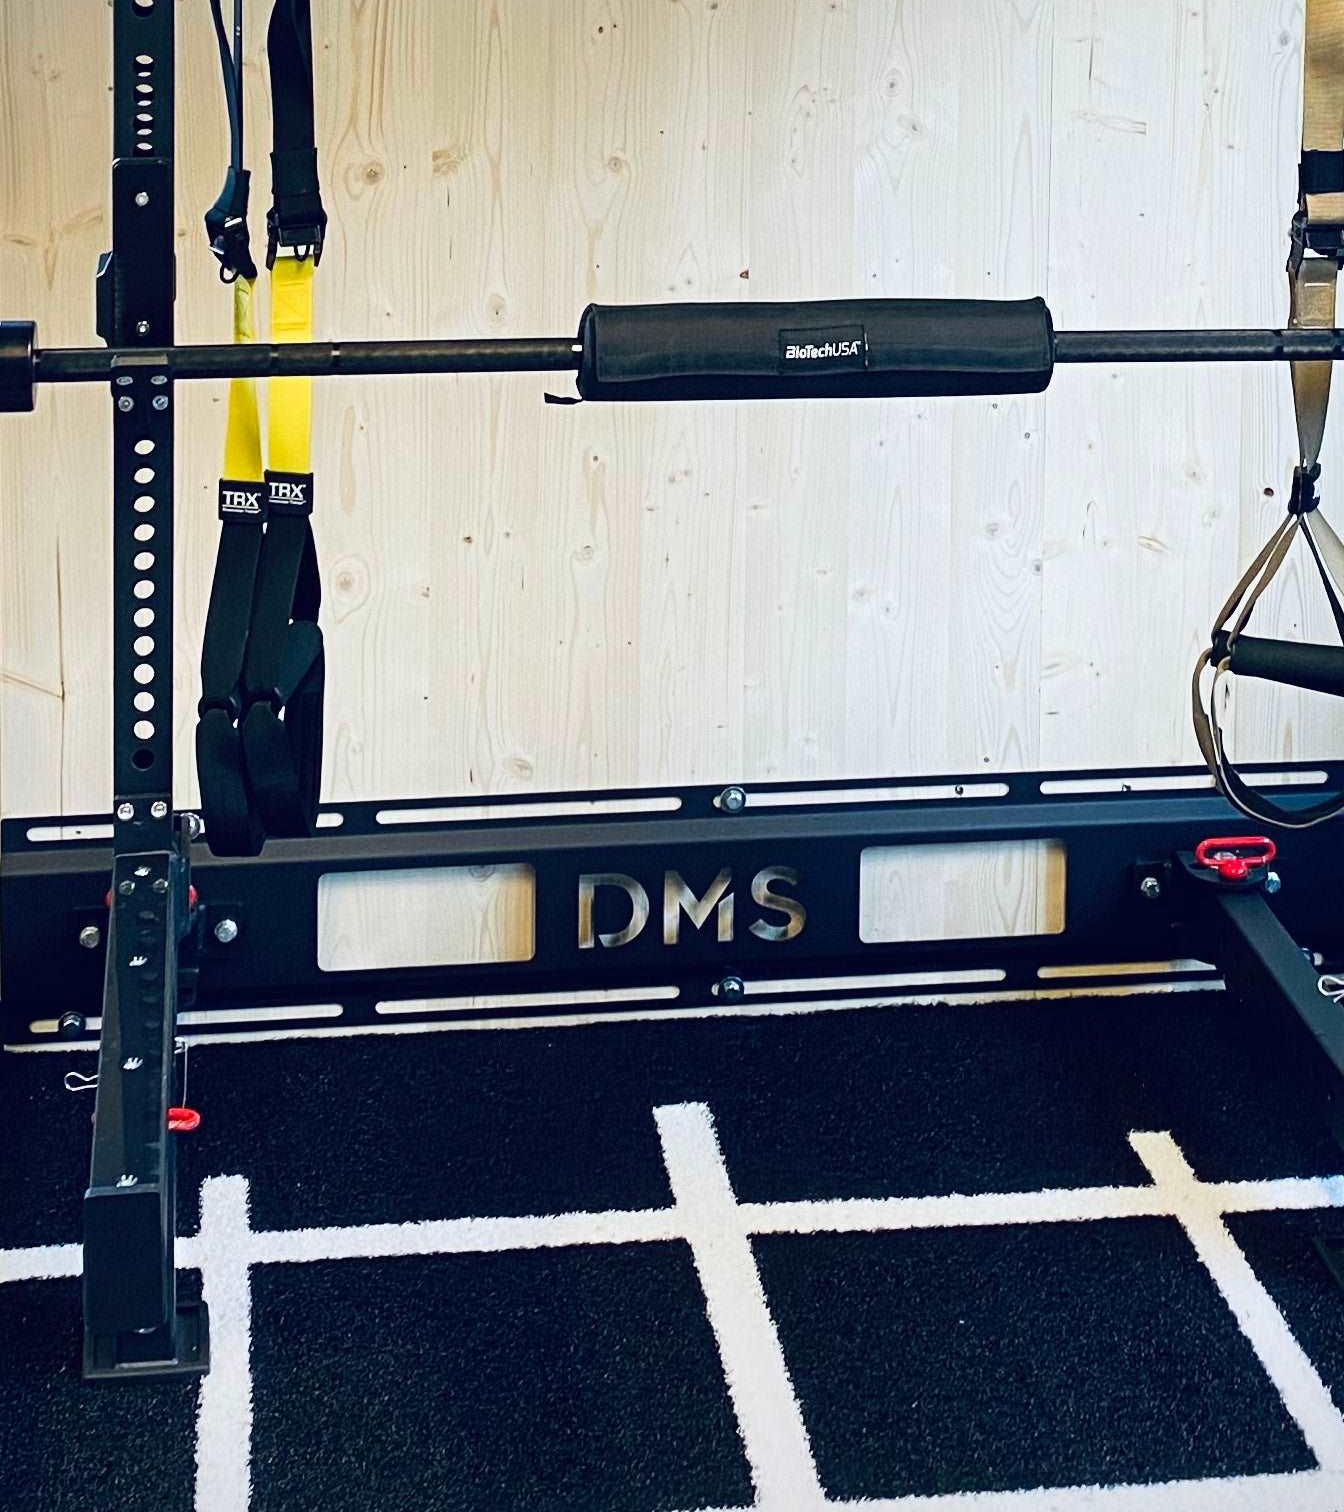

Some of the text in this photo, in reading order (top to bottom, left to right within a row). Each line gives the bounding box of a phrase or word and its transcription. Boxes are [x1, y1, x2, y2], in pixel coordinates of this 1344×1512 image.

[222, 490, 259, 509] TRX
[268, 482, 304, 500] TRX
[577, 865, 807, 950] DMS
